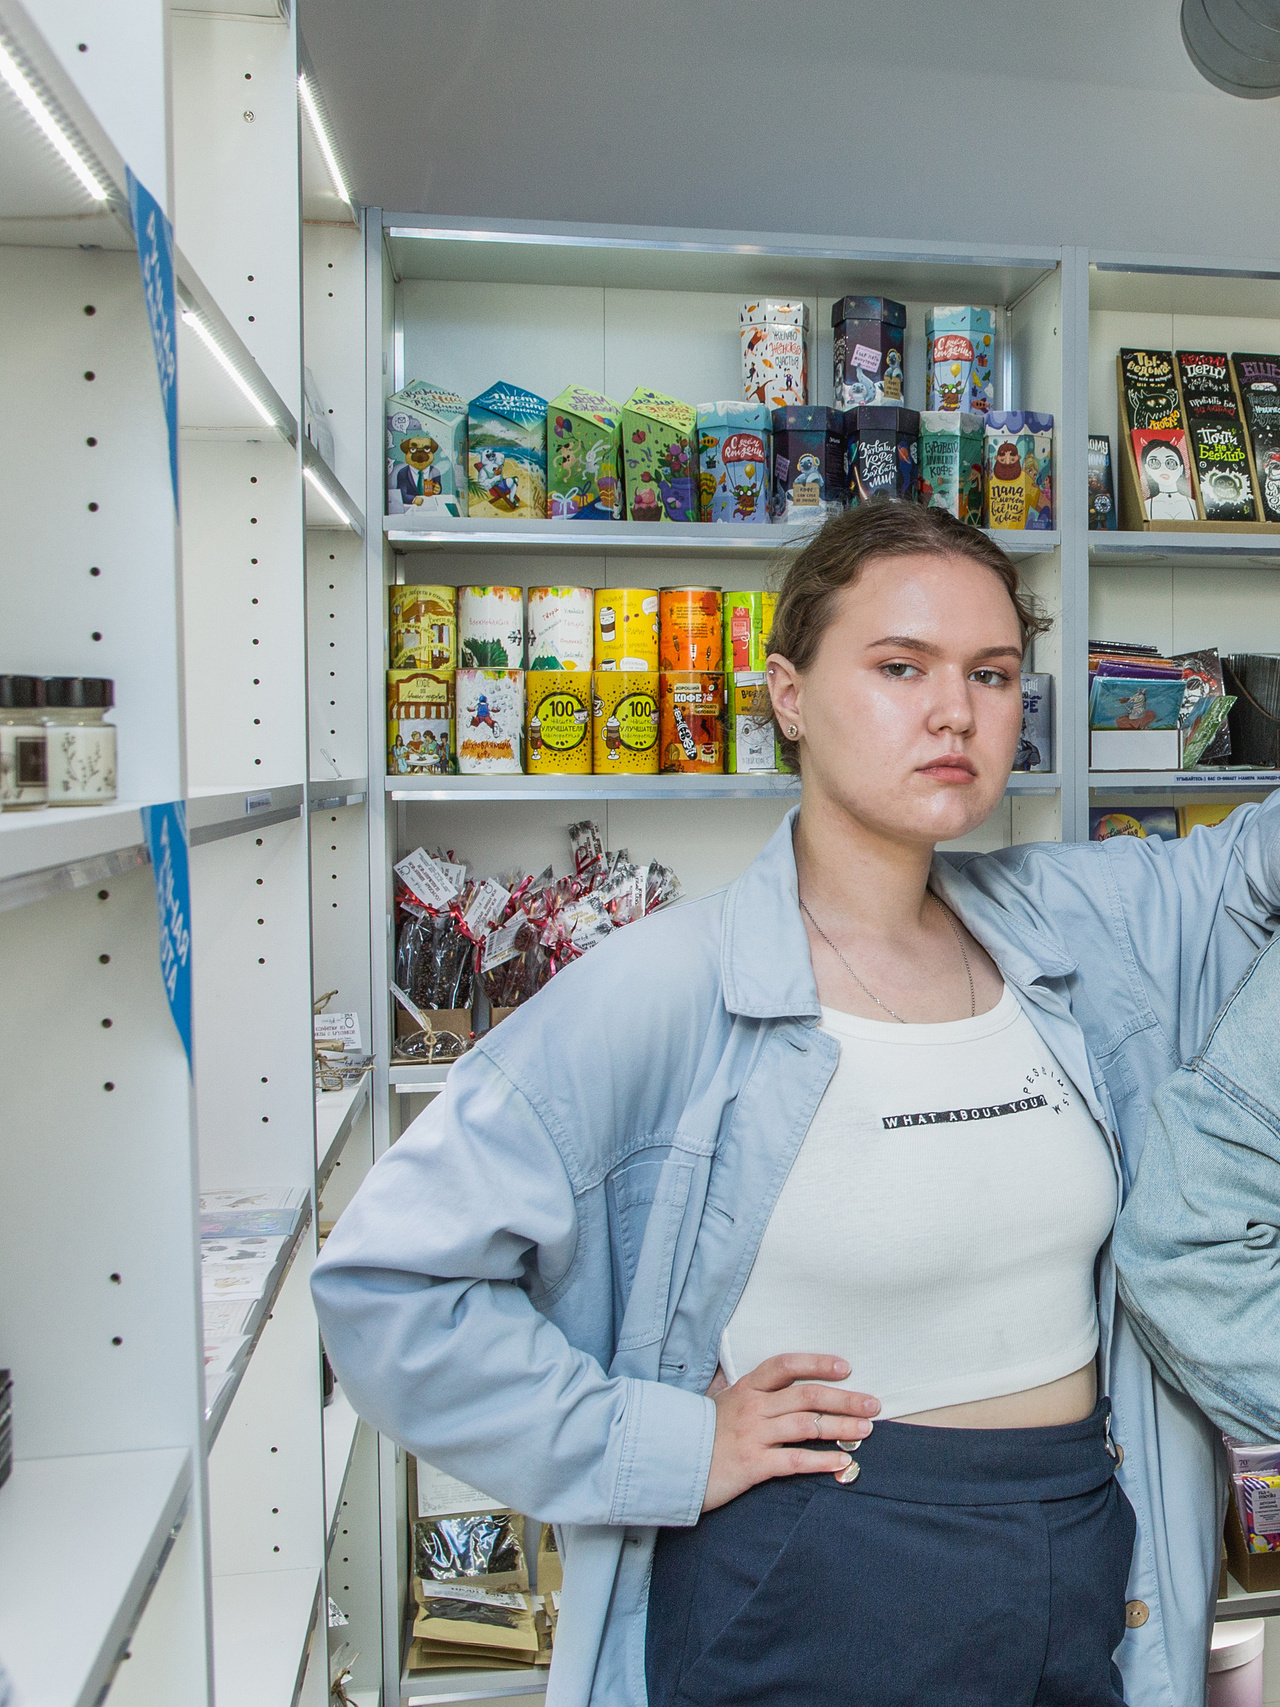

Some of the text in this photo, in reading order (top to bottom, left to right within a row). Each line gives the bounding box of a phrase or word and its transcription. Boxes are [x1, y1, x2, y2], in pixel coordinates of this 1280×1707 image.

[930, 464, 953, 478] КОФЕ
[674, 693, 702, 703] КОФЕ
[549, 701, 574, 717] 100
[629, 701, 652, 717] 100
[885, 1095, 1047, 1128] WHAT ABOUT YOU?
